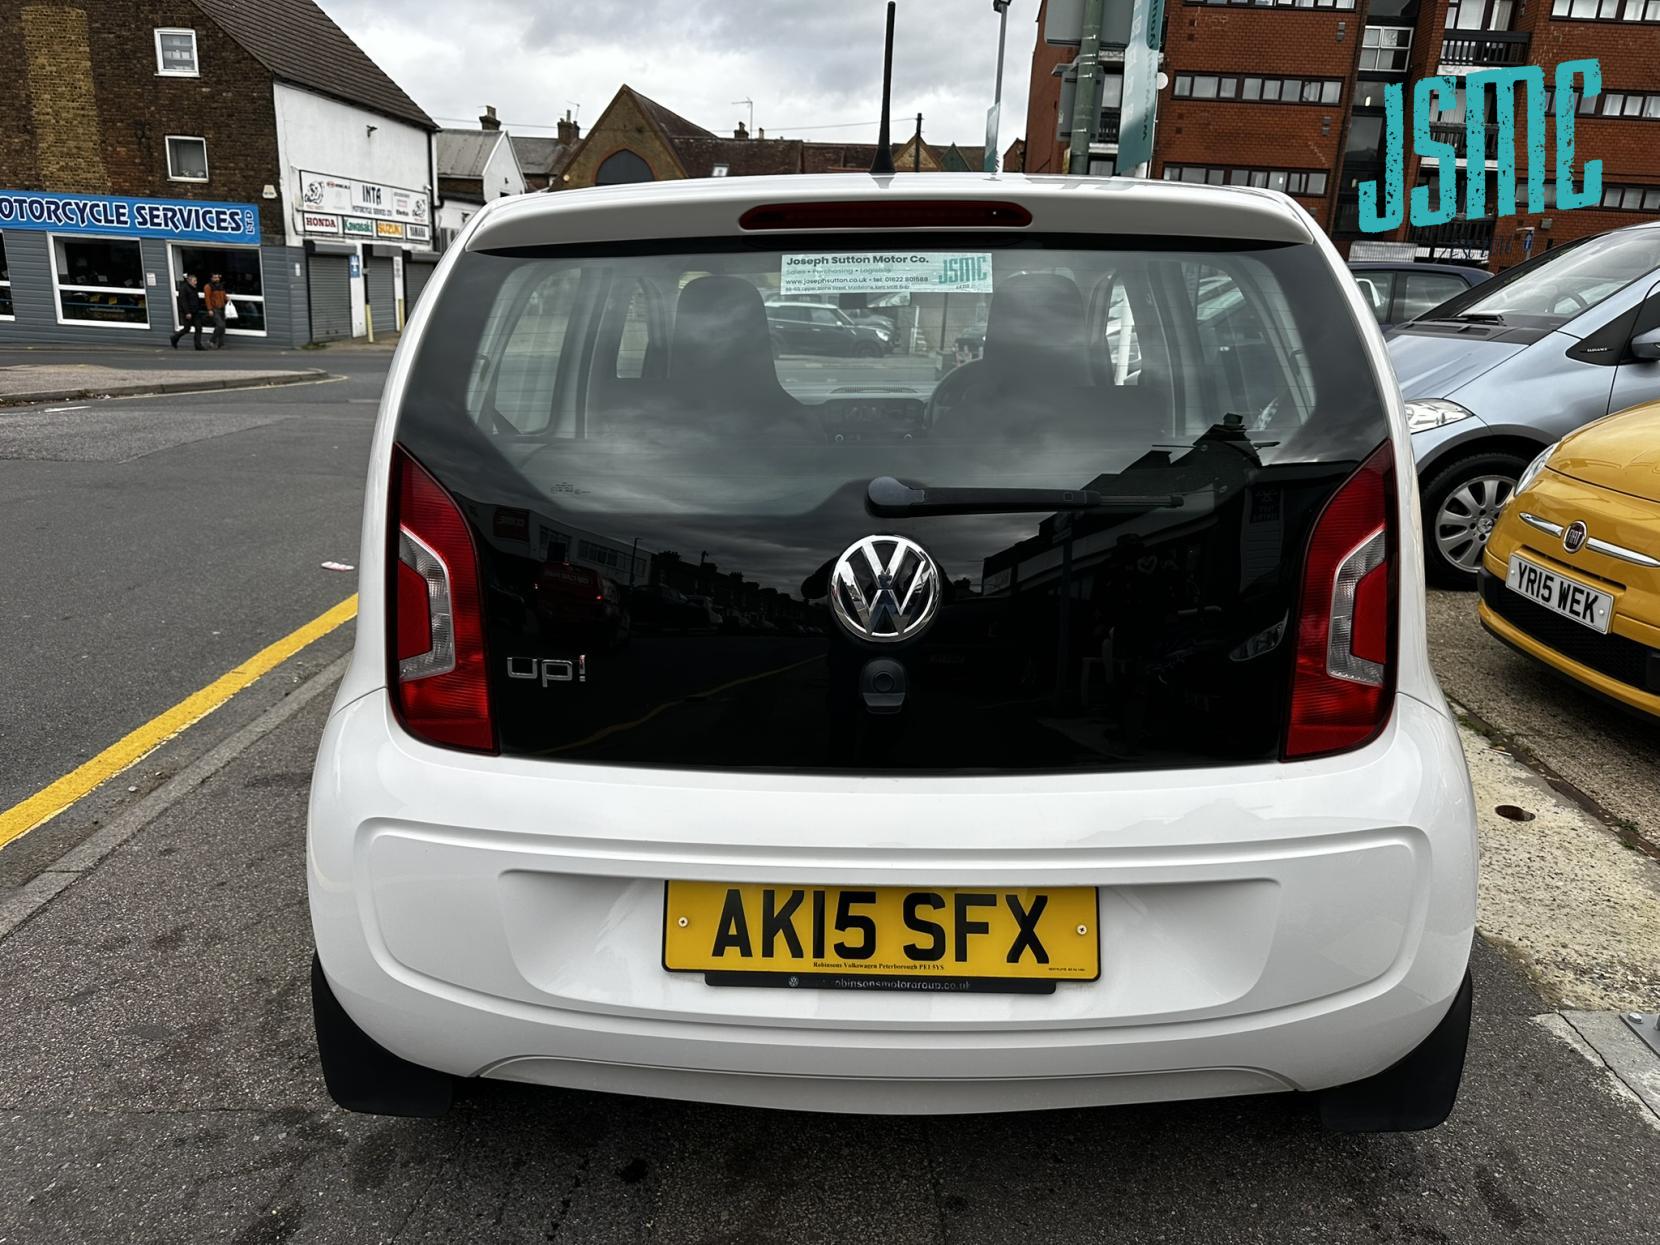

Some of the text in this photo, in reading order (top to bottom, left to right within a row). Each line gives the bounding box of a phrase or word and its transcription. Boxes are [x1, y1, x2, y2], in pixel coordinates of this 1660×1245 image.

[362, 185, 382, 205] INTA
[0, 196, 243, 233] OTORCYCLE SERVICES
[244, 210, 255, 234] LTD
[305, 217, 336, 228] HONDA
[344, 218, 373, 232] Kawasaki
[786, 255, 929, 268] Joseph Sutton Motor Co.
[938, 256, 988, 284] JSMC
[785, 276, 867, 286] www.josephsutton.co.uk
[1568, 528, 1583, 546] FIAT
[1518, 562, 1599, 623] YR15 WEK
[507, 654, 586, 688] up!
[712, 888, 1050, 964] AK15 SFX
